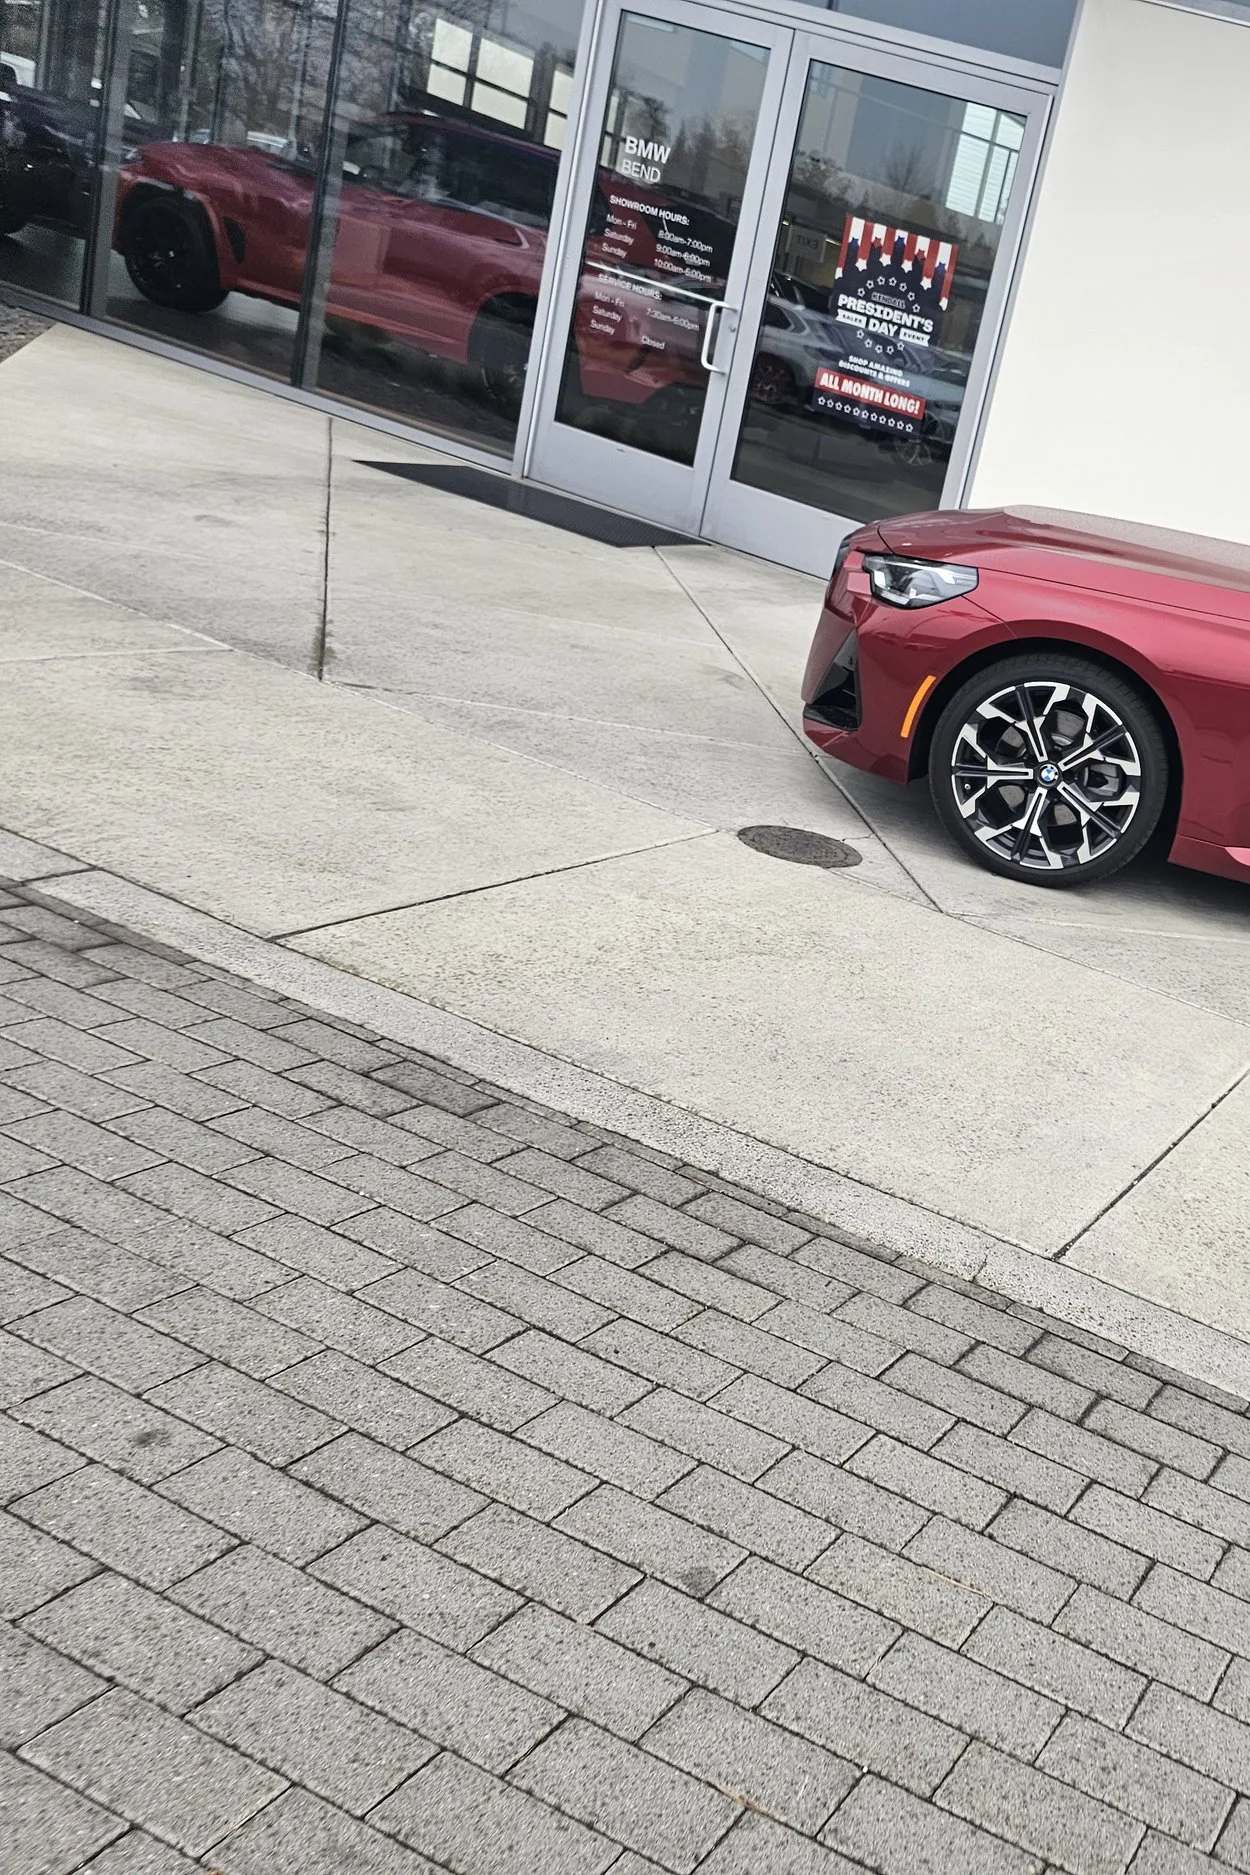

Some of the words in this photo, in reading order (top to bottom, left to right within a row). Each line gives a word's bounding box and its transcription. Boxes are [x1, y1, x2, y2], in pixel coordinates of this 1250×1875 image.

[625, 135, 671, 164] BMW
[621, 159, 661, 183] BEND
[606, 213, 622, 226] Mon
[627, 219, 637, 230] Fri
[609, 194, 658, 216] SHOWROOM
[658, 208, 690, 226] HOURS:
[604, 228, 634, 246] Saturday
[601, 242, 627, 258] Sunday
[598, 273, 631, 290] SERVICE
[632, 283, 663, 301] HOURS:
[594, 291, 610, 303] Mon
[615, 298, 625, 308] Fri
[592, 305, 622, 322] Saturday
[837, 293, 934, 333] PRESIDENT'S
[590, 319, 615, 336] Sunday
[867, 318, 899, 337] DAY
[903, 331, 925, 342] EVENT
[641, 335, 666, 350] Closed
[838, 359, 877, 378] DISCOUNTS
[884, 374, 910, 387] OFFERS
[848, 354, 868, 367] SHOP
[868, 361, 903, 377] AMAZING
[819, 372, 840, 391] ALL
[840, 379, 884, 404] MONTH
[883, 391, 921, 415] LONG!
